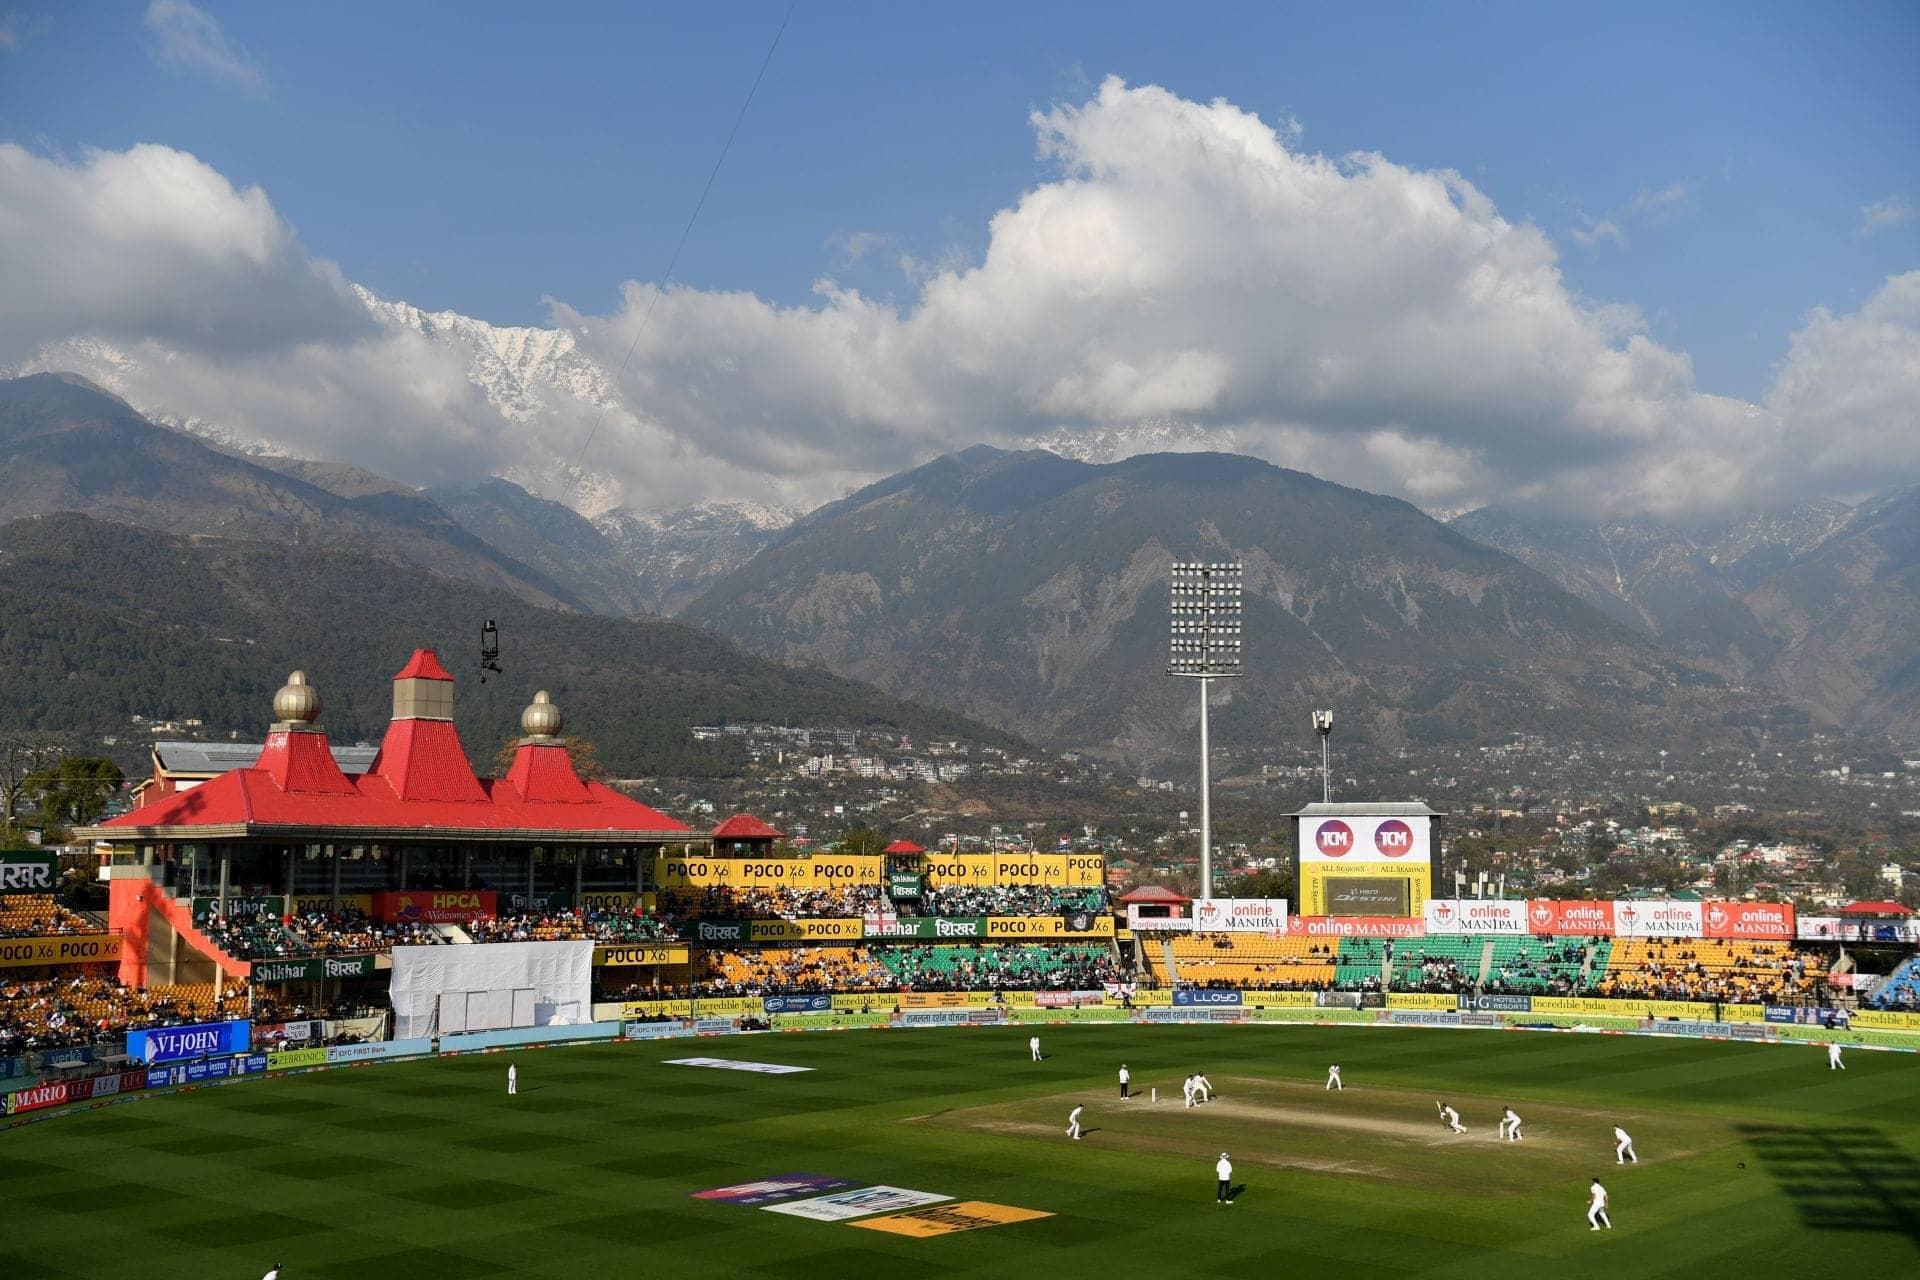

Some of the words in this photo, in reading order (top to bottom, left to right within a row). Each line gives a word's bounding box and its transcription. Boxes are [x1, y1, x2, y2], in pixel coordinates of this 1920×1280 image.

[1321, 831, 1348, 846] TCM
[1380, 831, 1407, 846] TCM
[1069, 858, 1102, 869] POCO
[667, 863, 707, 877] POCO
[713, 863, 729, 876] X6
[744, 864, 784, 877] POCO
[789, 864, 805, 877] X6
[814, 864, 854, 877] POCO
[859, 865, 875, 877] X6
[927, 864, 966, 877] POCO
[972, 864, 987, 877] X6
[1000, 864, 1039, 877] POCO
[1045, 865, 1060, 876] X6
[1081, 871, 1093, 880] X6
[433, 894, 481, 909] HPCA
[1234, 903, 1272, 916] online
[1470, 906, 1510, 918] online
[1566, 907, 1604, 919] online
[1653, 908, 1692, 920] online
[1742, 909, 1783, 923] online
[991, 921, 1026, 933] POCO
[1031, 922, 1045, 933] X6
[1225, 917, 1282, 928] MANIPAL
[1308, 919, 1352, 933] online
[1356, 923, 1421, 935] MANIPAL
[1461, 919, 1521, 930] MANIPAL
[1558, 920, 1615, 930] MANIPAL
[1645, 921, 1699, 932] MANIPAL
[1733, 922, 1791, 935] MANIPAL
[752, 924, 785, 936] POCO
[789, 925, 802, 936] X6
[808, 923, 841, 935] POCO
[845, 924, 858, 934] X6
[38, 945, 54, 958] X6
[61, 942, 99, 957] POCO
[104, 942, 119, 954] X6
[605, 949, 645, 963] POCO
[650, 948, 666, 961] X6
[256, 964, 306, 982] Shikhar
[833, 995, 876, 1005] Incredible
[1194, 994, 1238, 1002] LLOYD
[1244, 992, 1289, 1003] Incredible
[1387, 994, 1432, 1005] Incredible
[1460, 996, 1490, 1009] IHG
[697, 1001, 740, 1012] Incredible
[1533, 999, 1581, 1009] Incredible
[1623, 1002, 1642, 1011] ALL
[841, 1015, 889, 1025] ZEBRONICS
[158, 1031, 219, 1055] VI-JOHN
[247, 1056, 266, 1066] instax
[278, 1051, 326, 1065] ZEBRONICS
[209, 1061, 227, 1071] instax
[16, 1084, 67, 1107] MARIO
